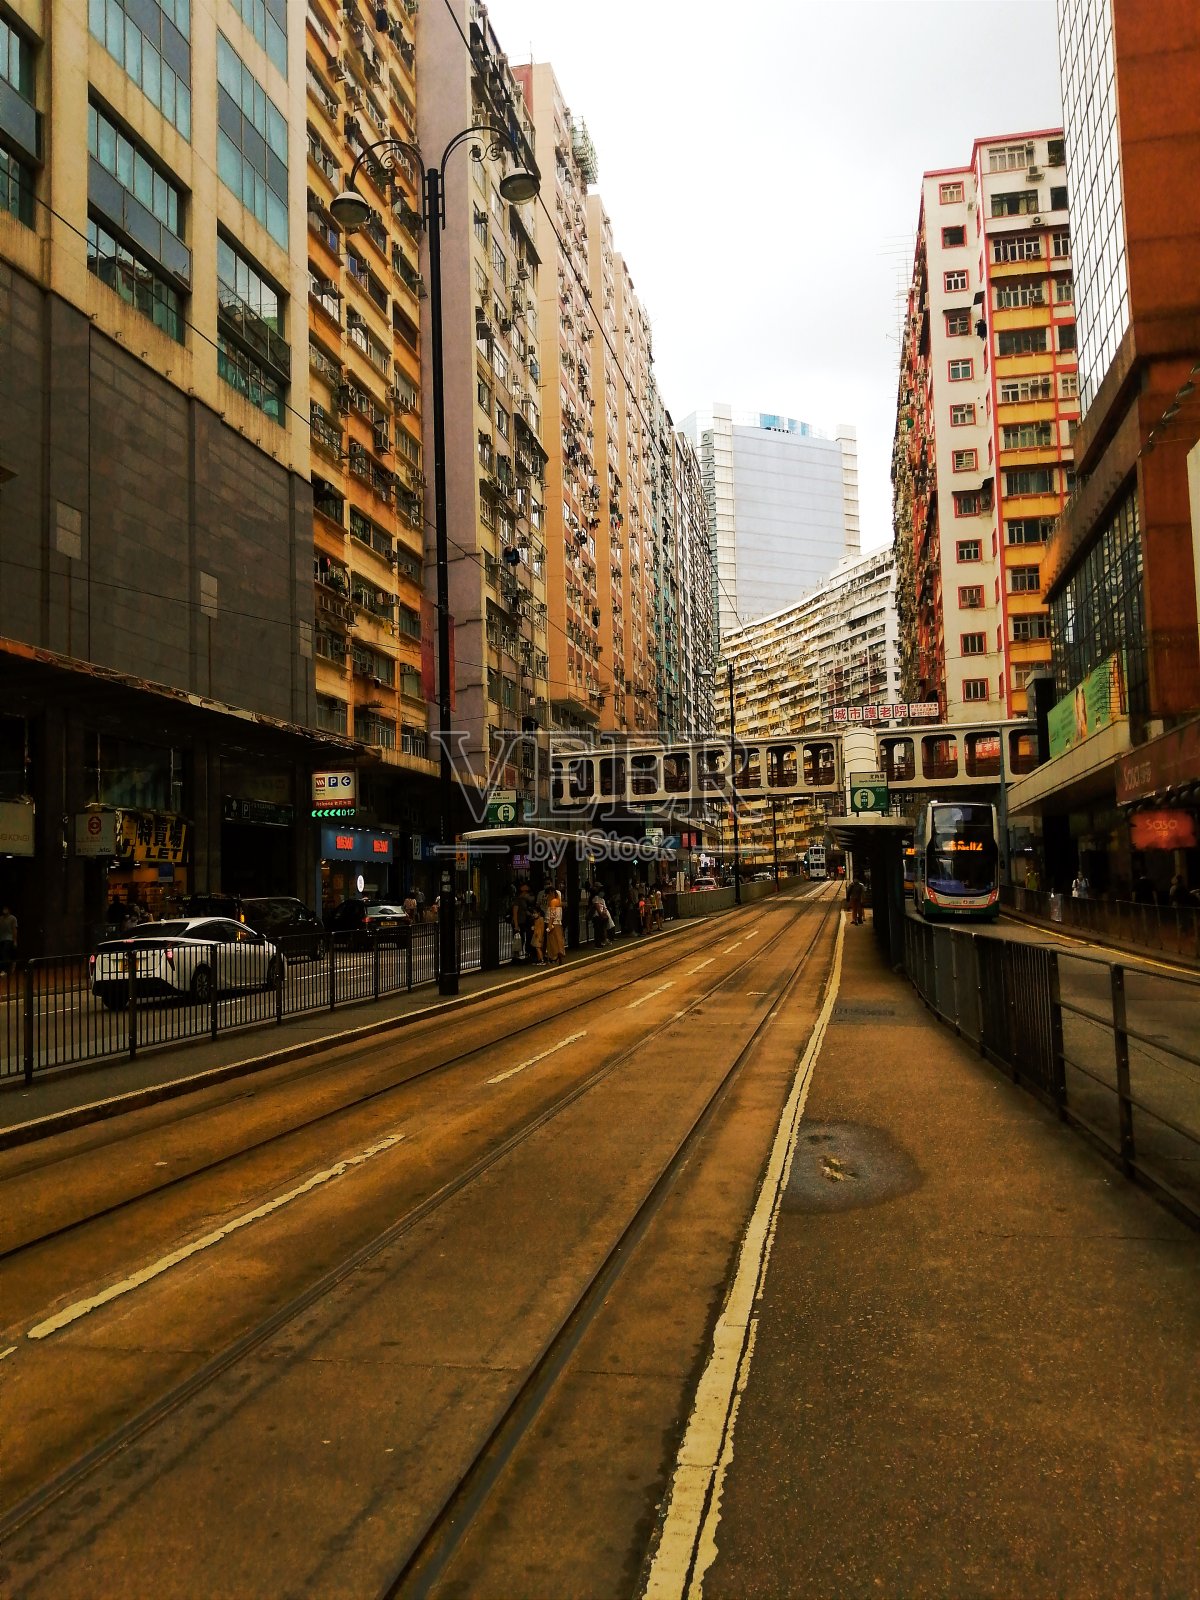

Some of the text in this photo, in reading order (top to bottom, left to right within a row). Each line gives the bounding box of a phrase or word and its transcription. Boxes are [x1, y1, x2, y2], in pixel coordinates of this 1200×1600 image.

[834, 704, 908, 721] 城市護老院
